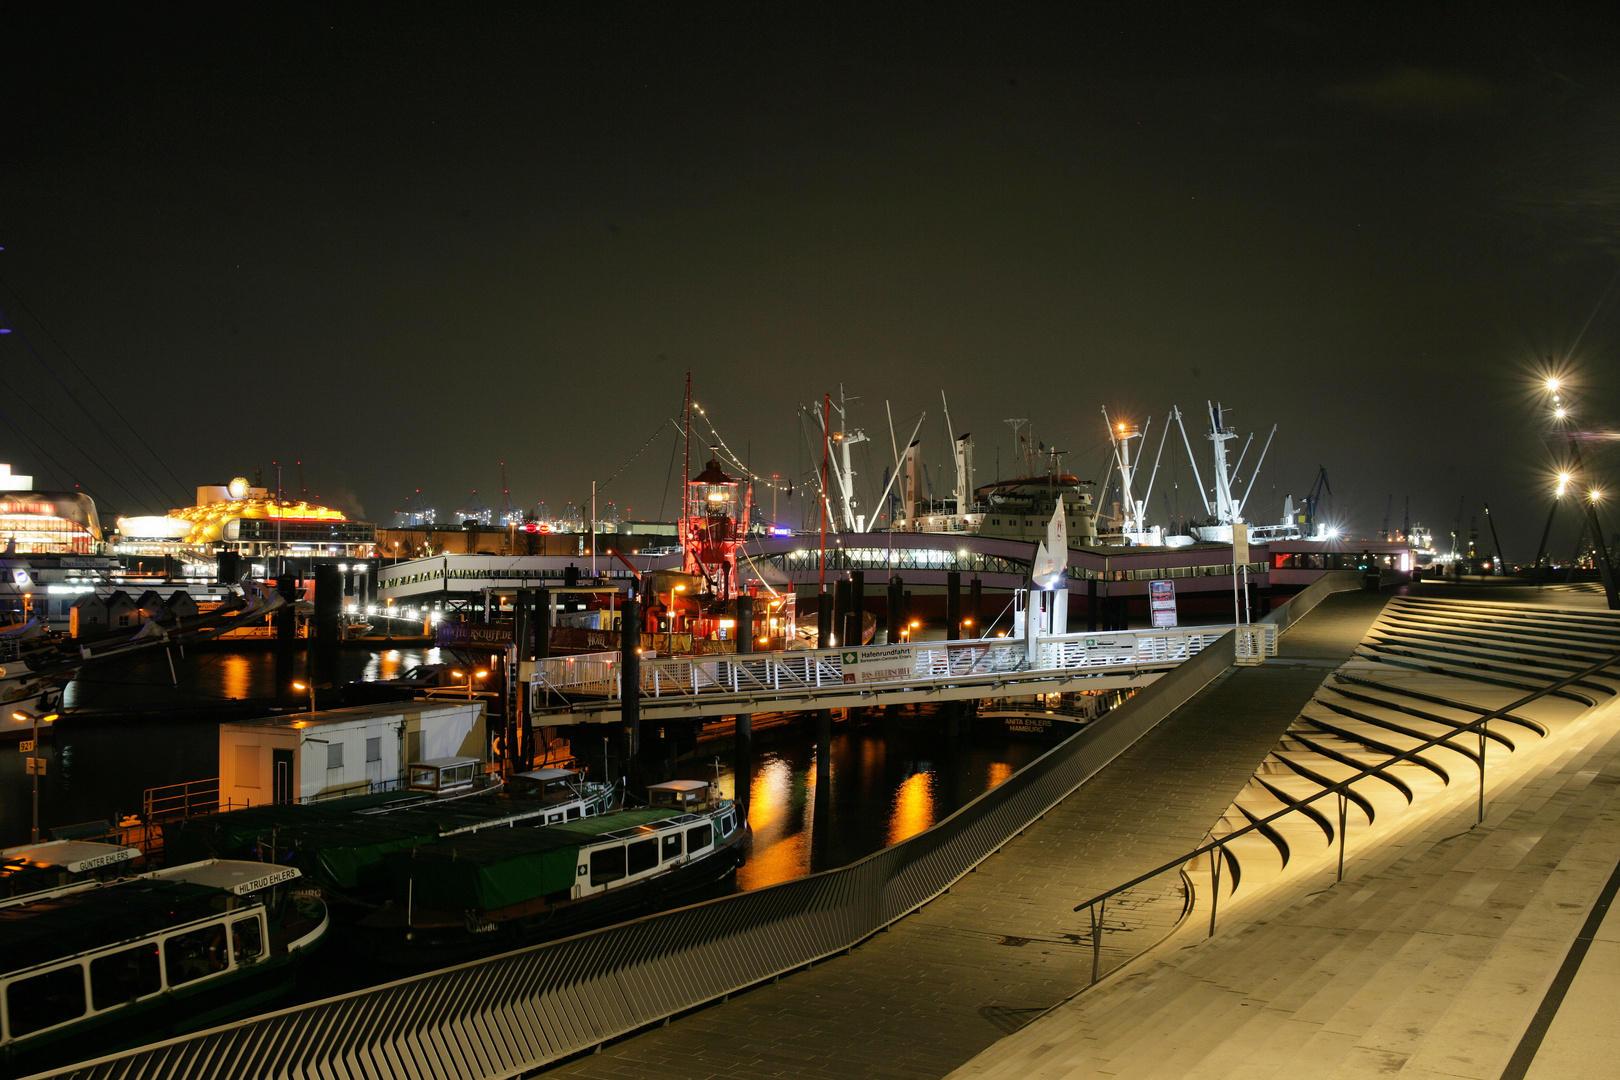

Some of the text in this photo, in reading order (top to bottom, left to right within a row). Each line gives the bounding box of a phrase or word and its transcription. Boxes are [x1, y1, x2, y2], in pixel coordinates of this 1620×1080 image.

[861, 648, 910, 659] Hafenrundfahrt
[1005, 718, 1053, 728] ANITA EHLERS
[1009, 725, 1044, 733] HAMBURG
[21, 742, 32, 751] 921
[106, 851, 129, 864] EHLERS
[239, 869, 296, 894] HILTRUD EHLERS
